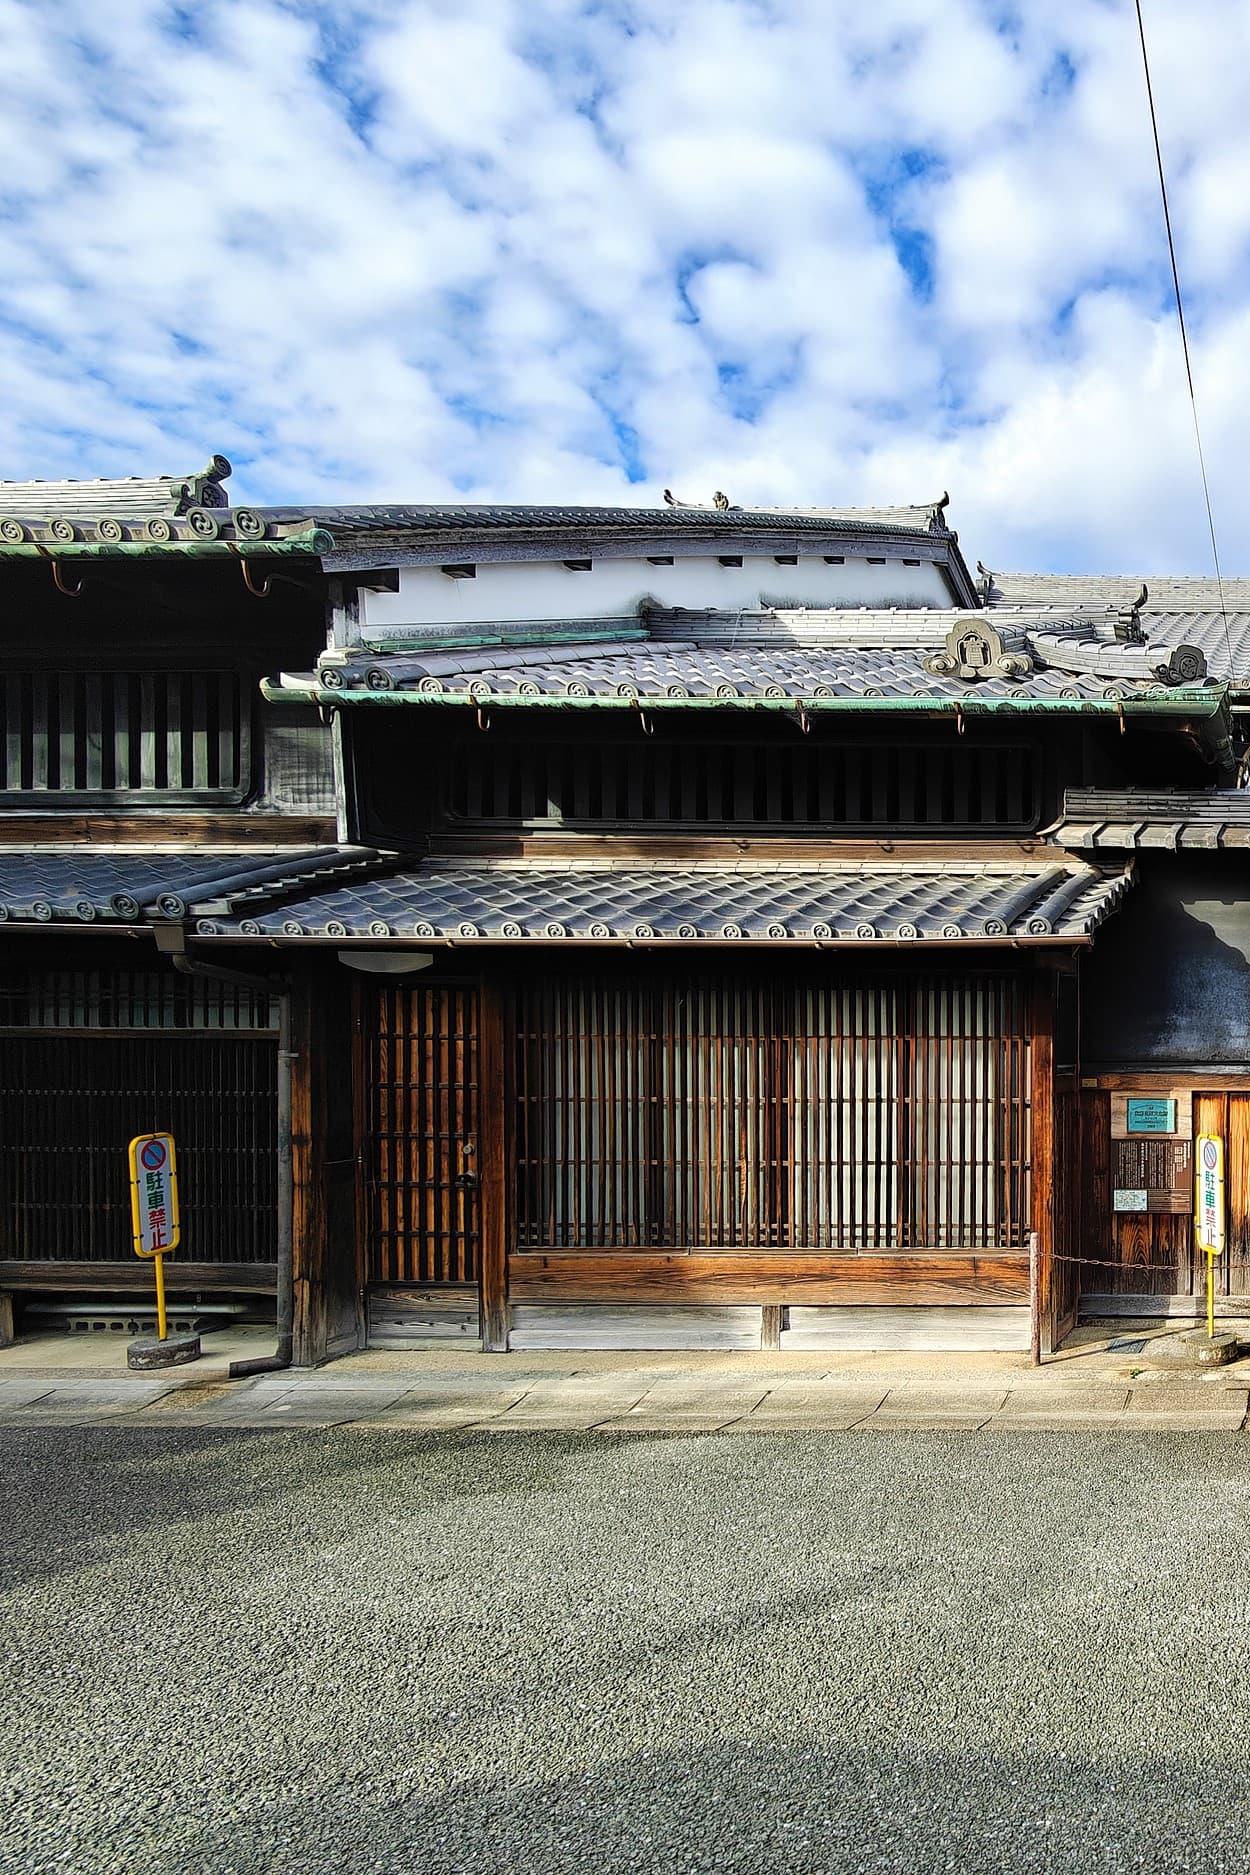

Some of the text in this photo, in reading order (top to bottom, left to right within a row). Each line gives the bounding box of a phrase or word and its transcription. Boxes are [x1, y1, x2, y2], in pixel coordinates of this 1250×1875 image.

[146, 1171, 167, 1250] 駐車禁止
[1204, 1170, 1218, 1248] 駐車禁止
